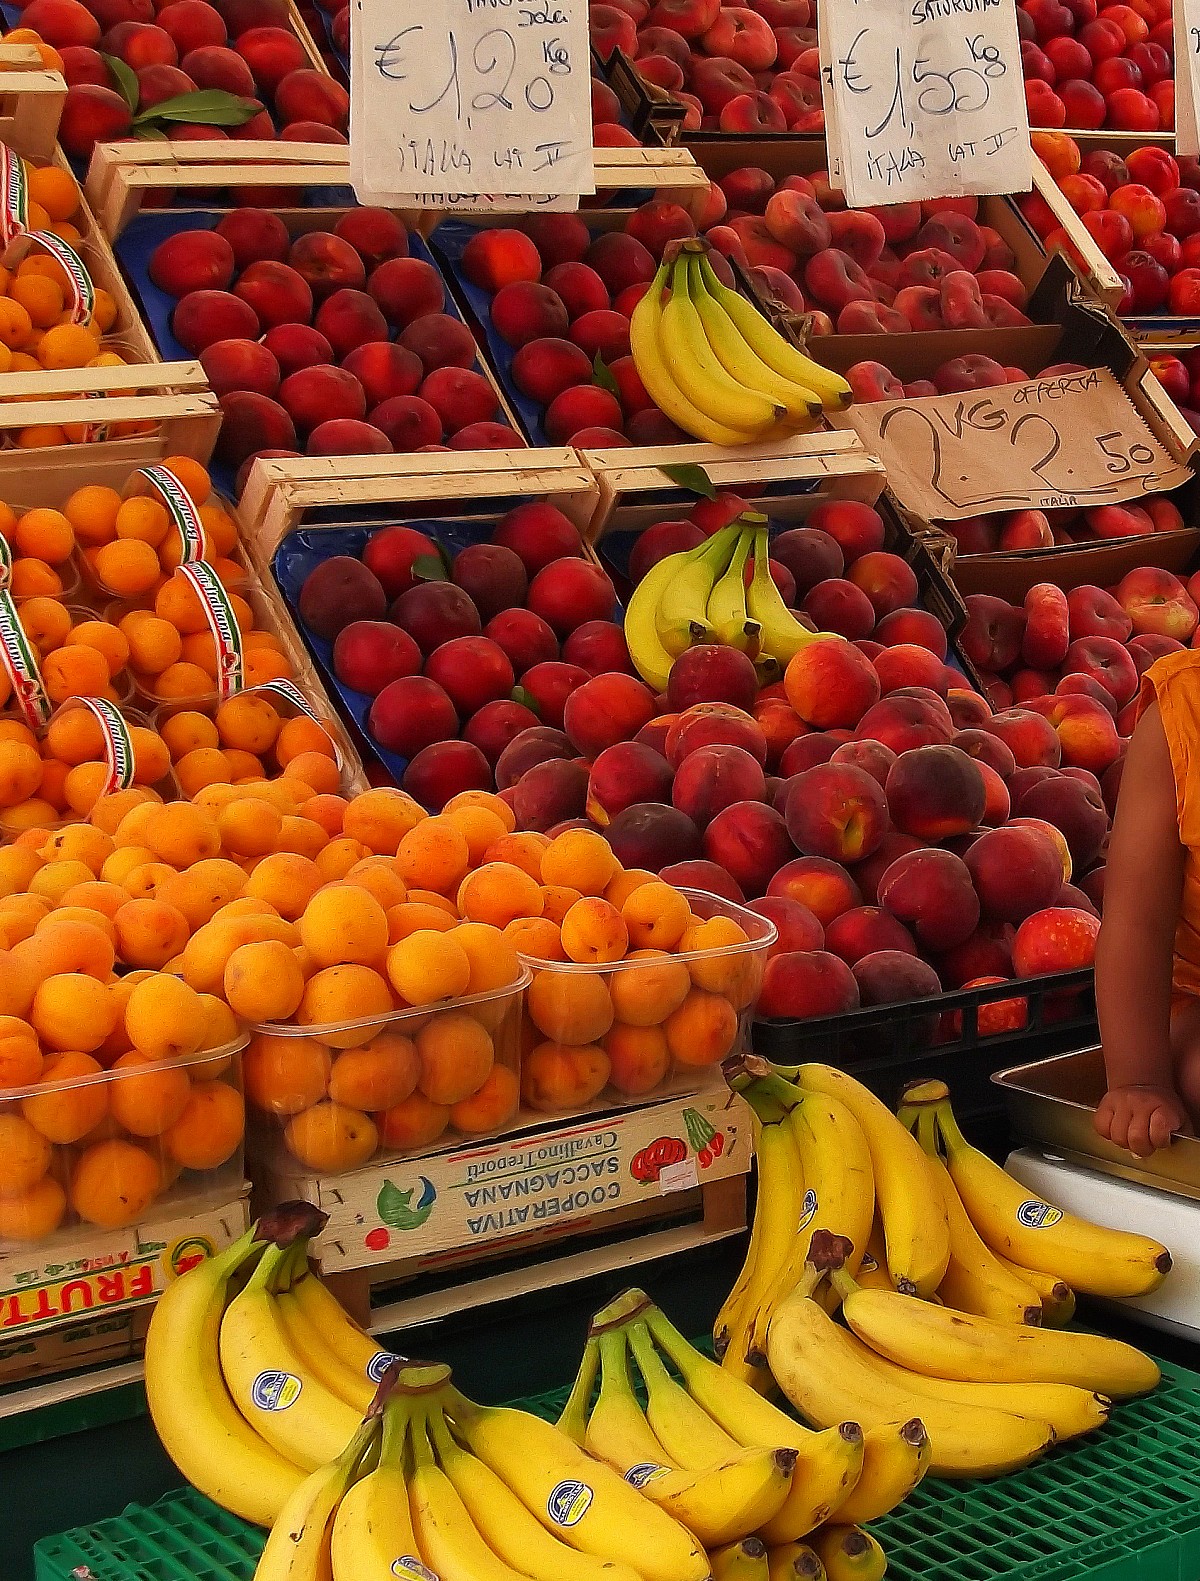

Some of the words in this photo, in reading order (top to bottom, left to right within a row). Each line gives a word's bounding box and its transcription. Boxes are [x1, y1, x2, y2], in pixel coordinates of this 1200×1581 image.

[1013, 371, 1103, 405] OFFERTA
[464, 1157, 620, 1208] SACCAGNANA
[466, 1181, 621, 1235] COOPERATIVA
[0, 1264, 153, 1326] FRUTT
